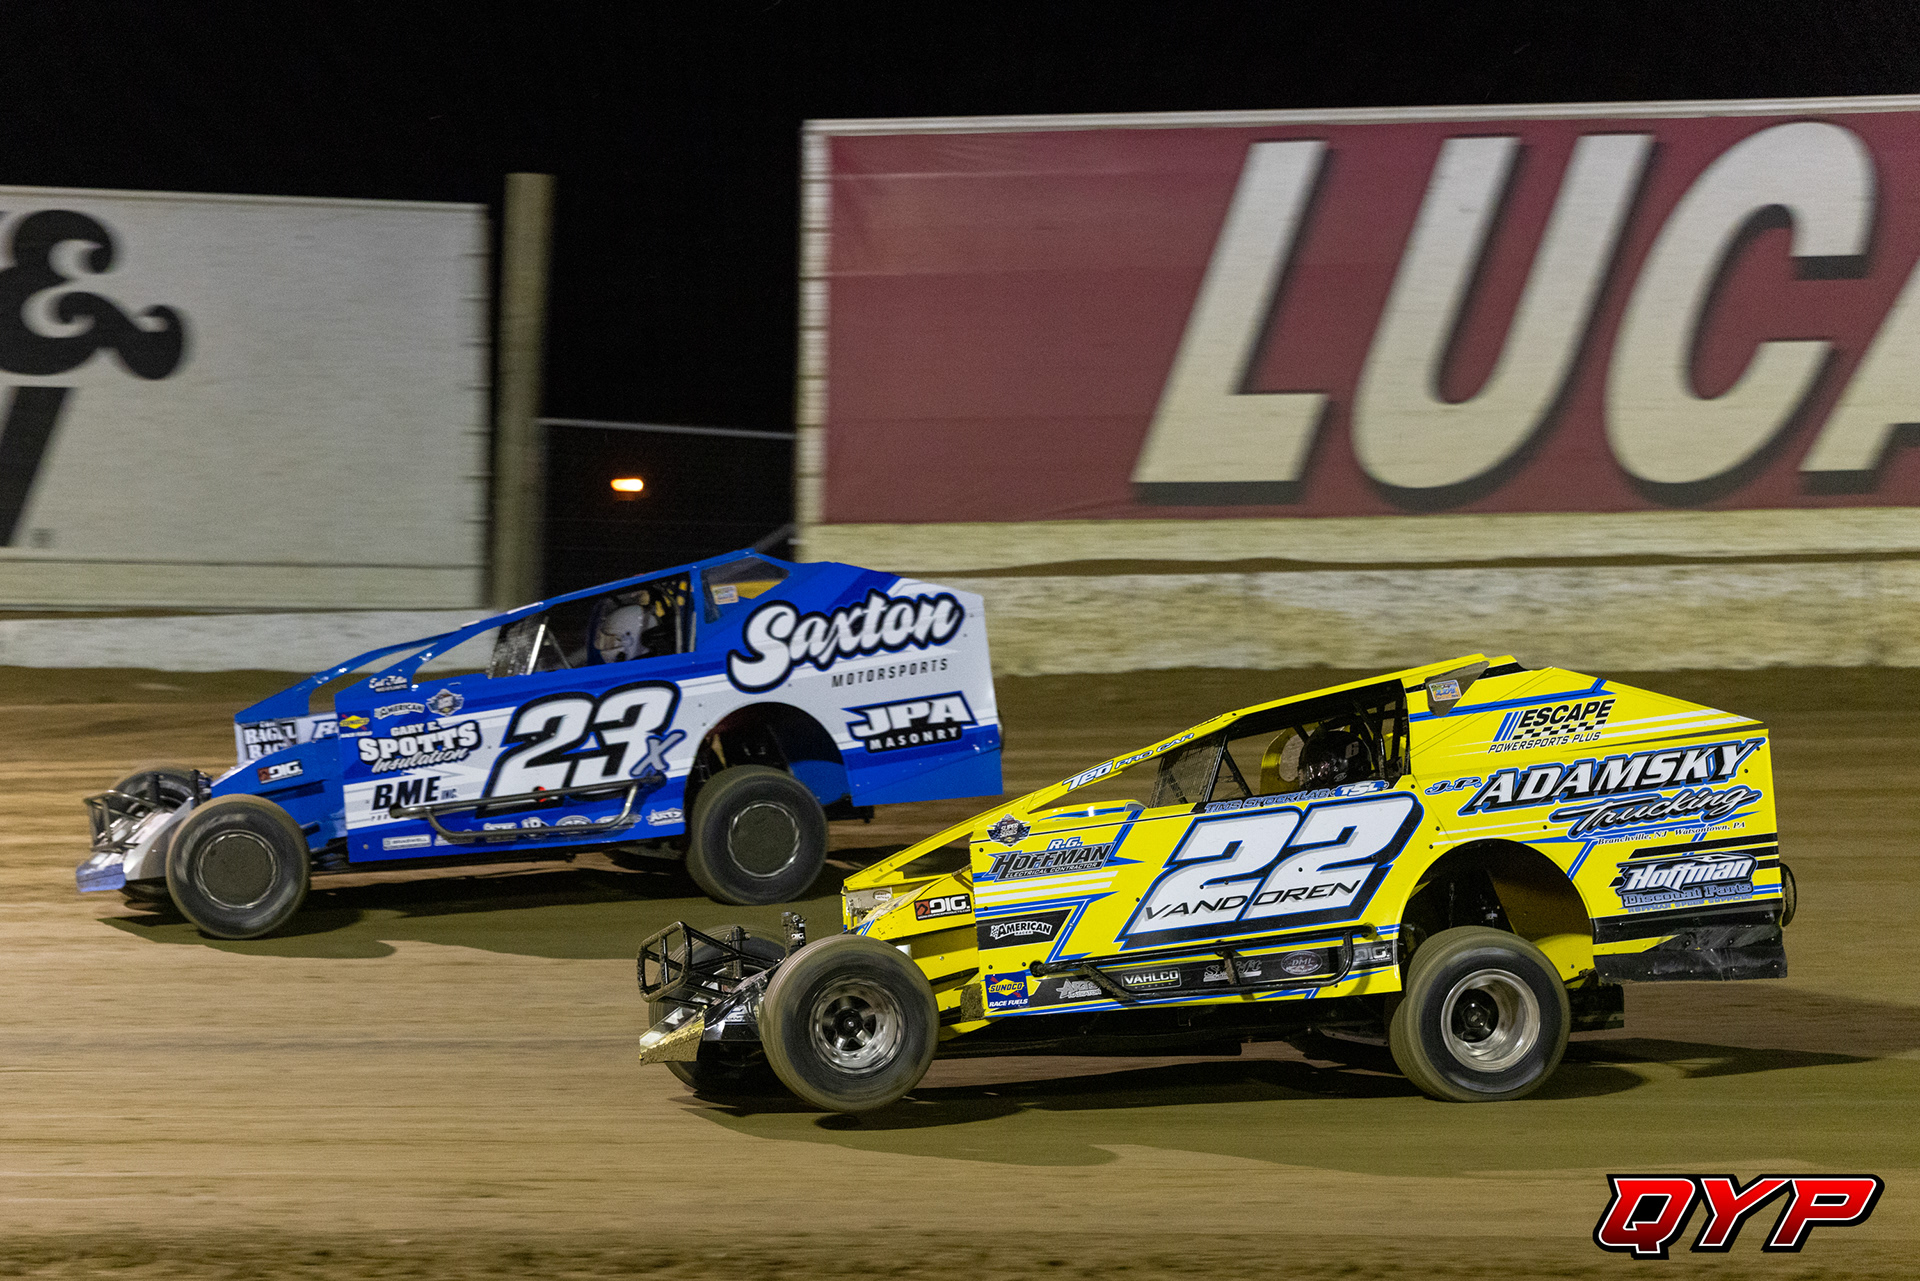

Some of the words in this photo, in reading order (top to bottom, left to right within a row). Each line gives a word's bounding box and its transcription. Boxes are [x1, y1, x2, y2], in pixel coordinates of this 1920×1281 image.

[728, 592, 962, 688] Saxton
[831, 658, 948, 688] MOTORSPORTS
[850, 696, 974, 738] JPA
[1517, 698, 1617, 729] ESCAPE
[358, 721, 478, 762] SPOTTS
[390, 723, 425, 736] GARY
[869, 727, 959, 750] MASONRY
[1487, 735, 1570, 754] POWERSPORTS
[1571, 731, 1602, 744] PLUS
[371, 747, 470, 773] Insulation
[1115, 750, 1153, 769] PRO
[1156, 733, 1195, 752] CAR
[1424, 777, 1482, 795] J.P.
[1464, 739, 1761, 811] ADAMSKY
[372, 776, 441, 811] BME
[1204, 799, 1243, 814] TIMS
[1244, 792, 1297, 809] SHOCK
[1297, 788, 1331, 801] LAB
[1339, 782, 1379, 797] TSL
[1552, 788, 1760, 837] Trucking
[1048, 837, 1082, 850] R.G.
[1597, 833, 1652, 845] Branchville,
[1674, 823, 1731, 836] Watsontown,
[1732, 821, 1746, 829] PA
[988, 843, 1114, 880] HOFFMAN
[1004, 868, 1048, 879] ELECTRICAL
[1049, 862, 1099, 873] CONTRACTOR
[1120, 797, 1415, 938] 22
[1623, 858, 1754, 892] Hoffman
[1704, 883, 1752, 897] Parts
[996, 921, 1053, 938] AMERICAN
[990, 982, 1023, 992] SUNOCO
[1123, 970, 1179, 985] VAHLCO
[1008, 998, 1029, 1006] FUELS
